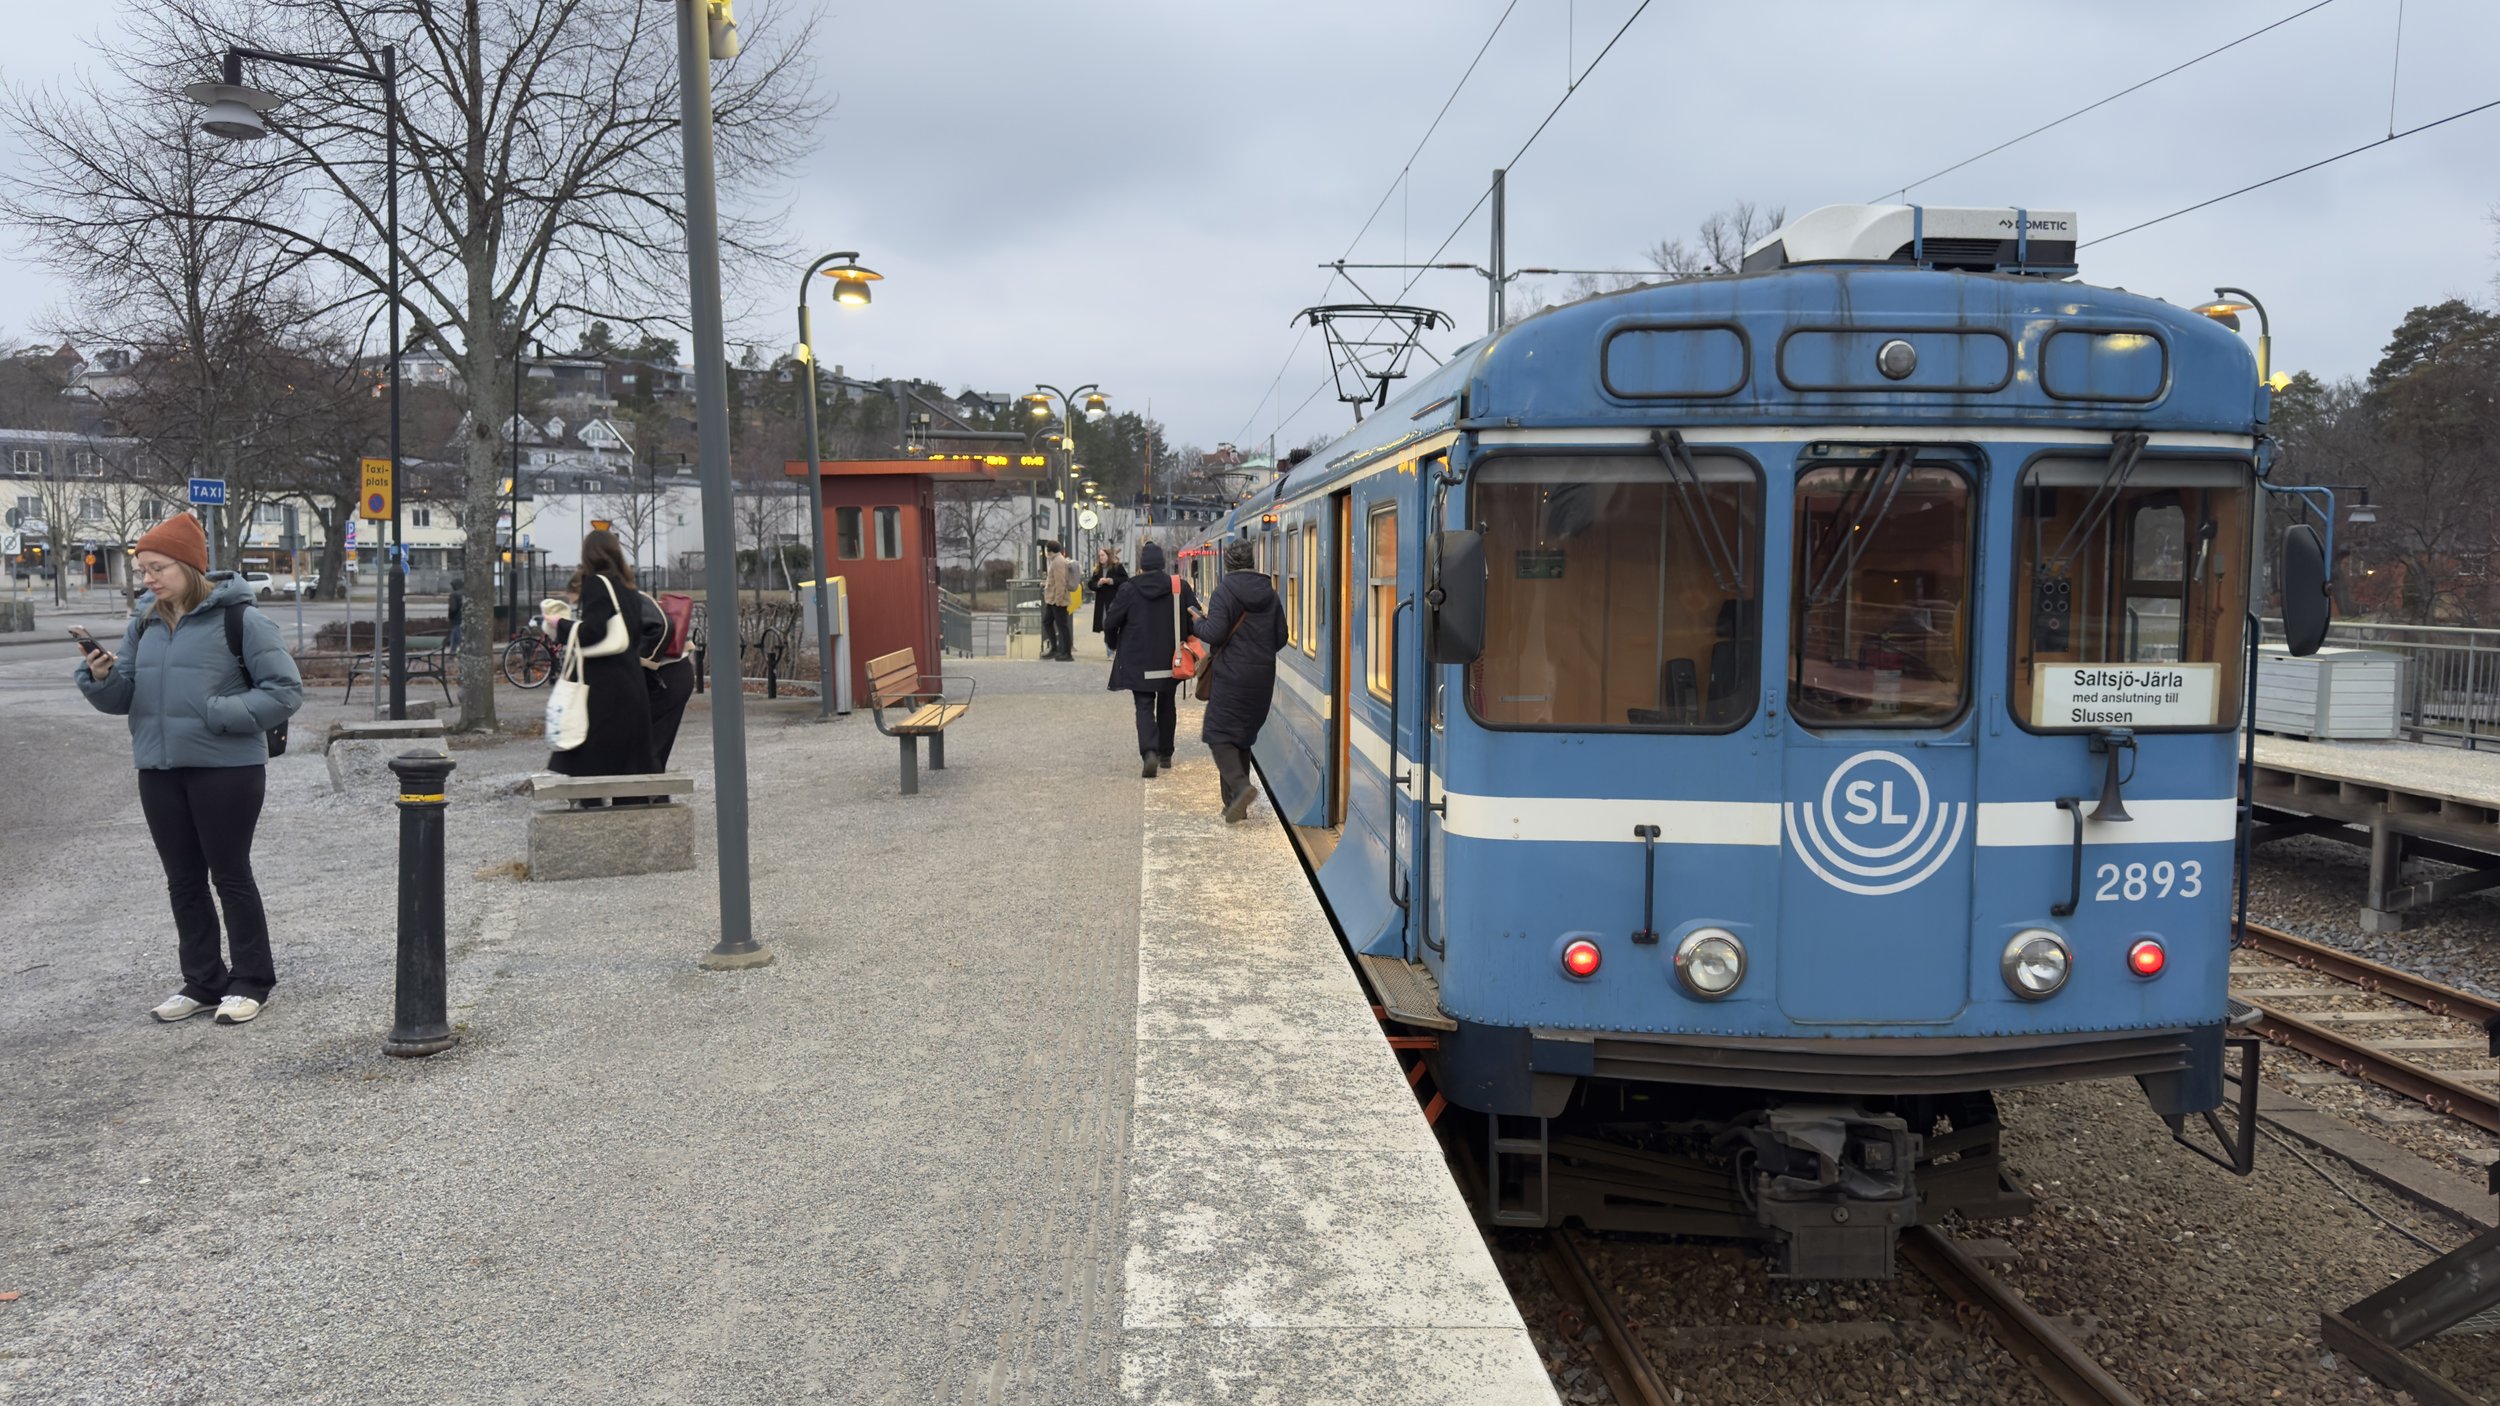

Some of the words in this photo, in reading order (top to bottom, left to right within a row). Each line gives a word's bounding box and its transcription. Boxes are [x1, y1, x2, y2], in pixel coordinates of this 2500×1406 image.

[365, 463, 390, 474] Taxi-
[366, 477, 389, 487] plats
[192, 485, 223, 499] TAXI
[2074, 669, 2183, 690] Saltsjö-Järla
[2072, 692, 2098, 703] med
[2101, 692, 2162, 705] anslutning
[2165, 692, 2179, 703] till
[2071, 708, 2133, 723] Slussen
[1844, 780, 1908, 825] SL
[2095, 860, 2203, 902] 2893
